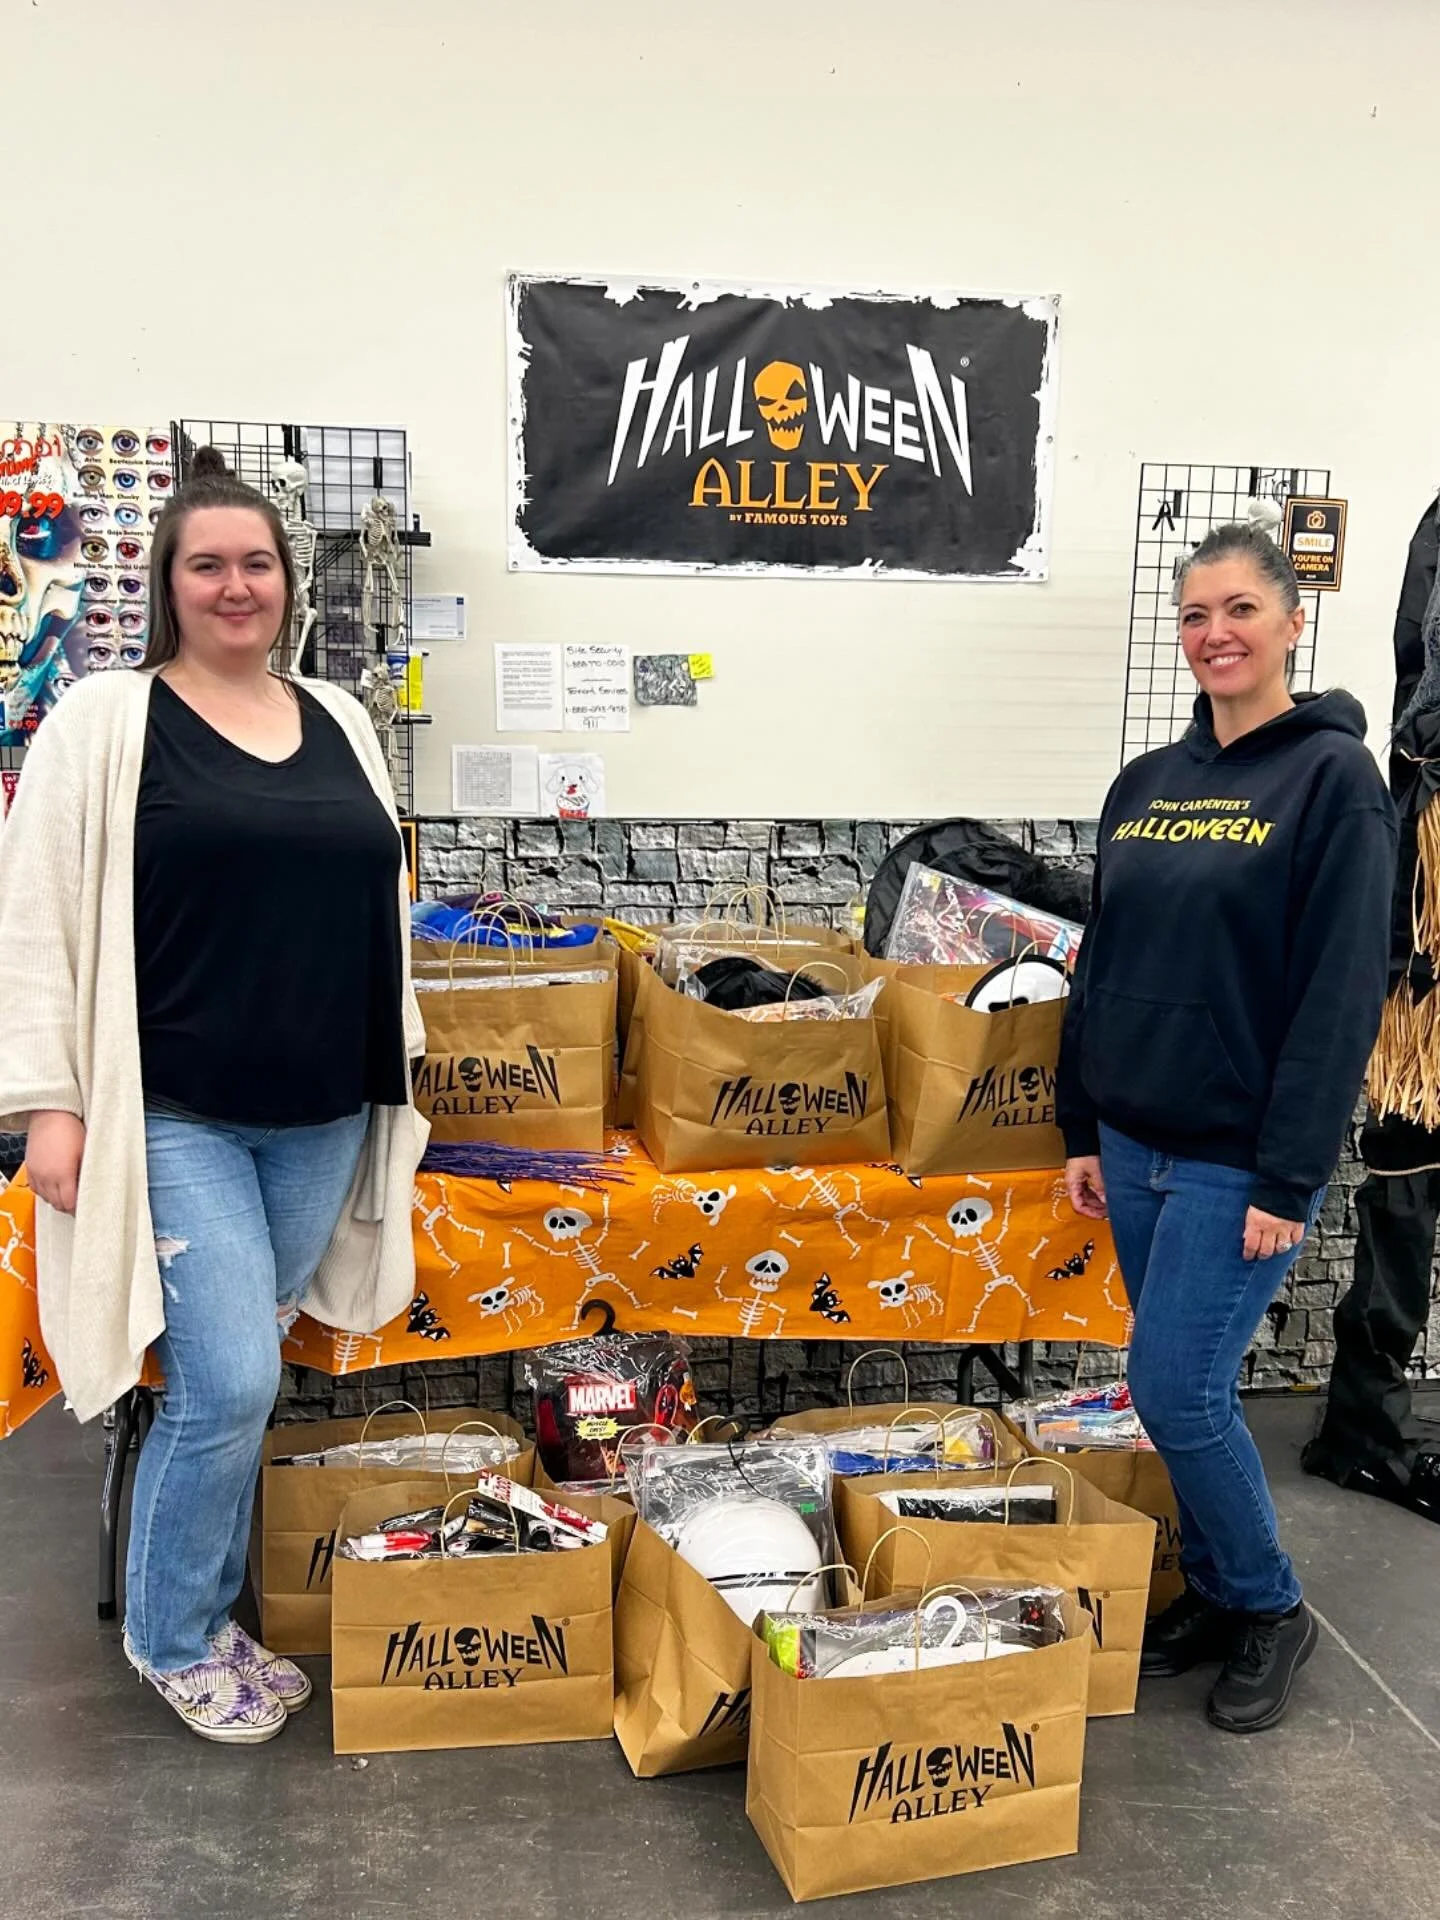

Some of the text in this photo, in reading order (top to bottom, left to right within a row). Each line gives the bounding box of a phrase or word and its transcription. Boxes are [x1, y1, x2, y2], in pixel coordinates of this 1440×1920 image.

[607, 334, 973, 496] HALLOWEEN
[688, 457, 889, 511] ALLEY
[744, 513, 807, 525] FAMOUS
[810, 514, 848, 526] TOYS
[1296, 536, 1332, 548] SMILE
[1292, 554, 1334, 564] YOU'RE ON
[1294, 563, 1330, 572] CAMERA
[566, 646, 623, 657] Site Security
[583, 718, 599, 729] 911
[1148, 798, 1251, 811] JOHN CARPENTER'S
[1110, 816, 1274, 847] HALLOWEEN
[431, 1095, 521, 1115] ALLEY
[710, 1071, 868, 1126] HALLOWEEN
[744, 1116, 833, 1136] ALLEY
[991, 1103, 1055, 1127] ALLE
[568, 1383, 635, 1412] MARVEL
[380, 1614, 568, 1685] HALLOWEEN
[423, 1667, 524, 1690] ALLEY
[848, 1722, 1035, 1824] HALLOWEEN
[890, 1783, 994, 1824] ALLEY
